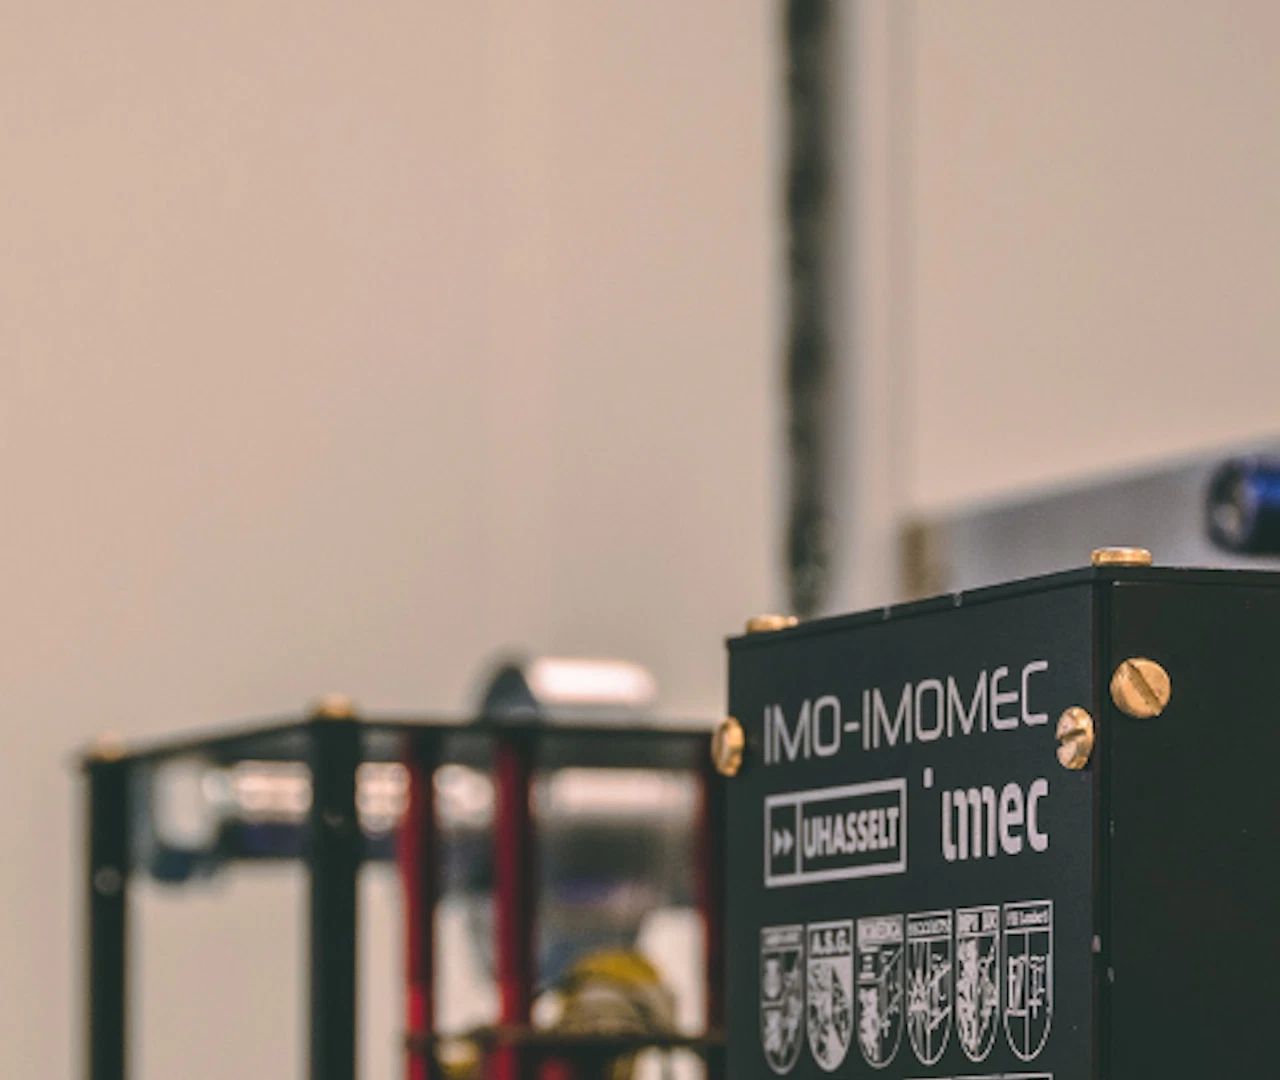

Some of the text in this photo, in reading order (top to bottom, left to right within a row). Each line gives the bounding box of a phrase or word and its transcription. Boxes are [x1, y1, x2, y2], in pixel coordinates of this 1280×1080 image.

[764, 660, 1048, 764] IMO-IMOMEC
[804, 807, 899, 858] UHASSELT
[923, 767, 1048, 861] imec
